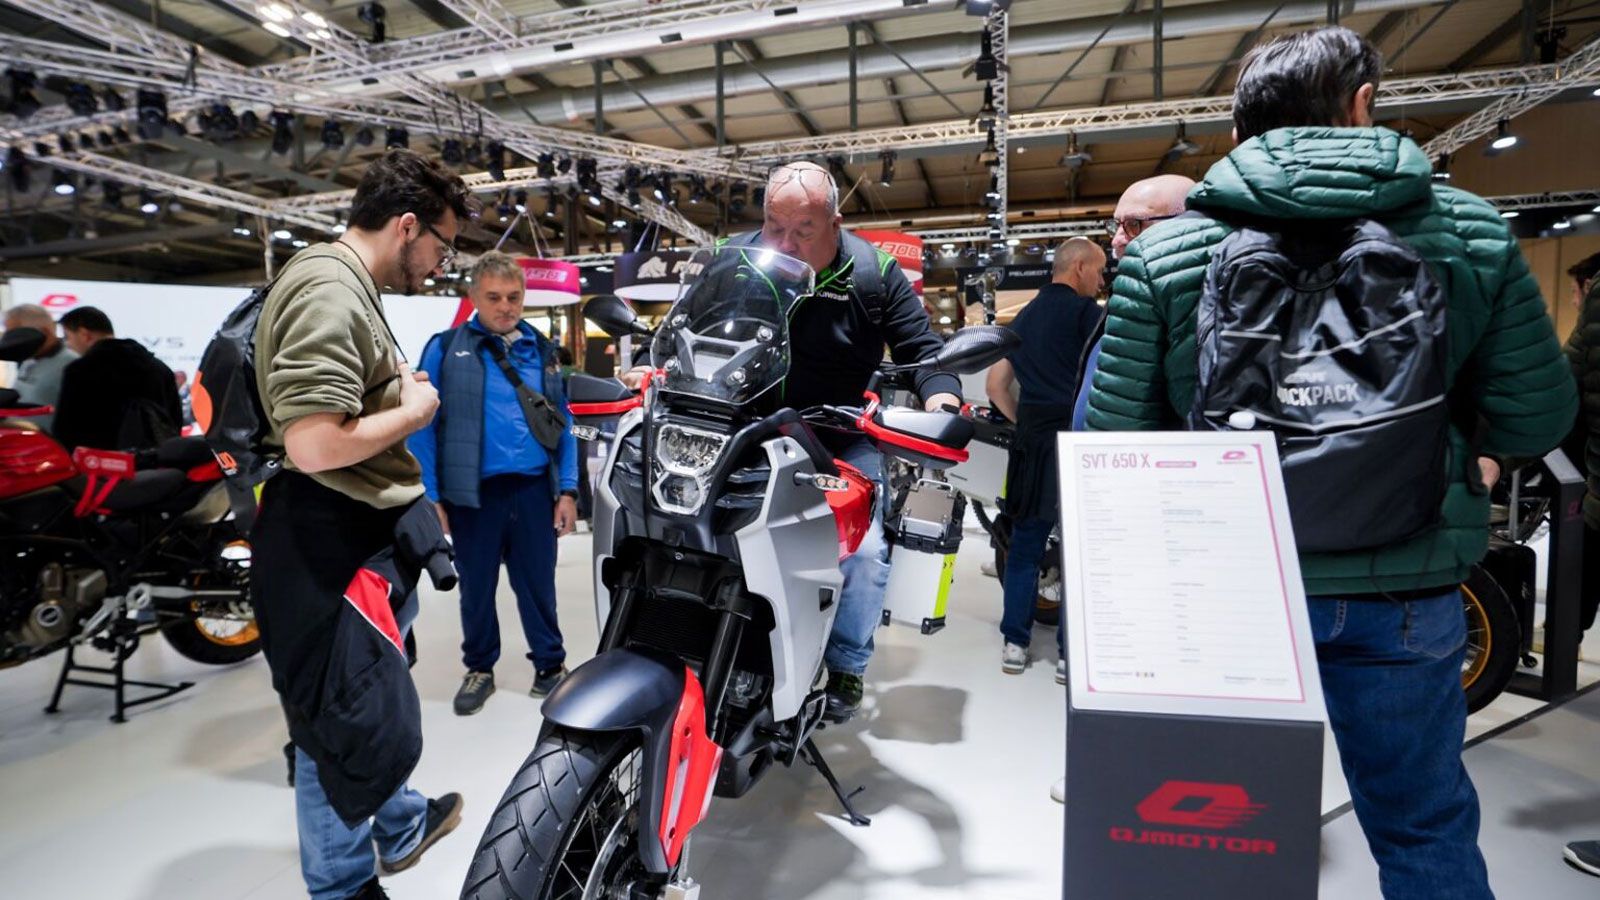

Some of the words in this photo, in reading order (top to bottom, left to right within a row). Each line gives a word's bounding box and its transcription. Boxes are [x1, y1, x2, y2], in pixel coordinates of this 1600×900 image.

[1081, 453, 1108, 469] SVT
[1112, 452, 1137, 469] 650
[1141, 453, 1151, 469] X
[1109, 826, 1277, 855] QJMOTOR
